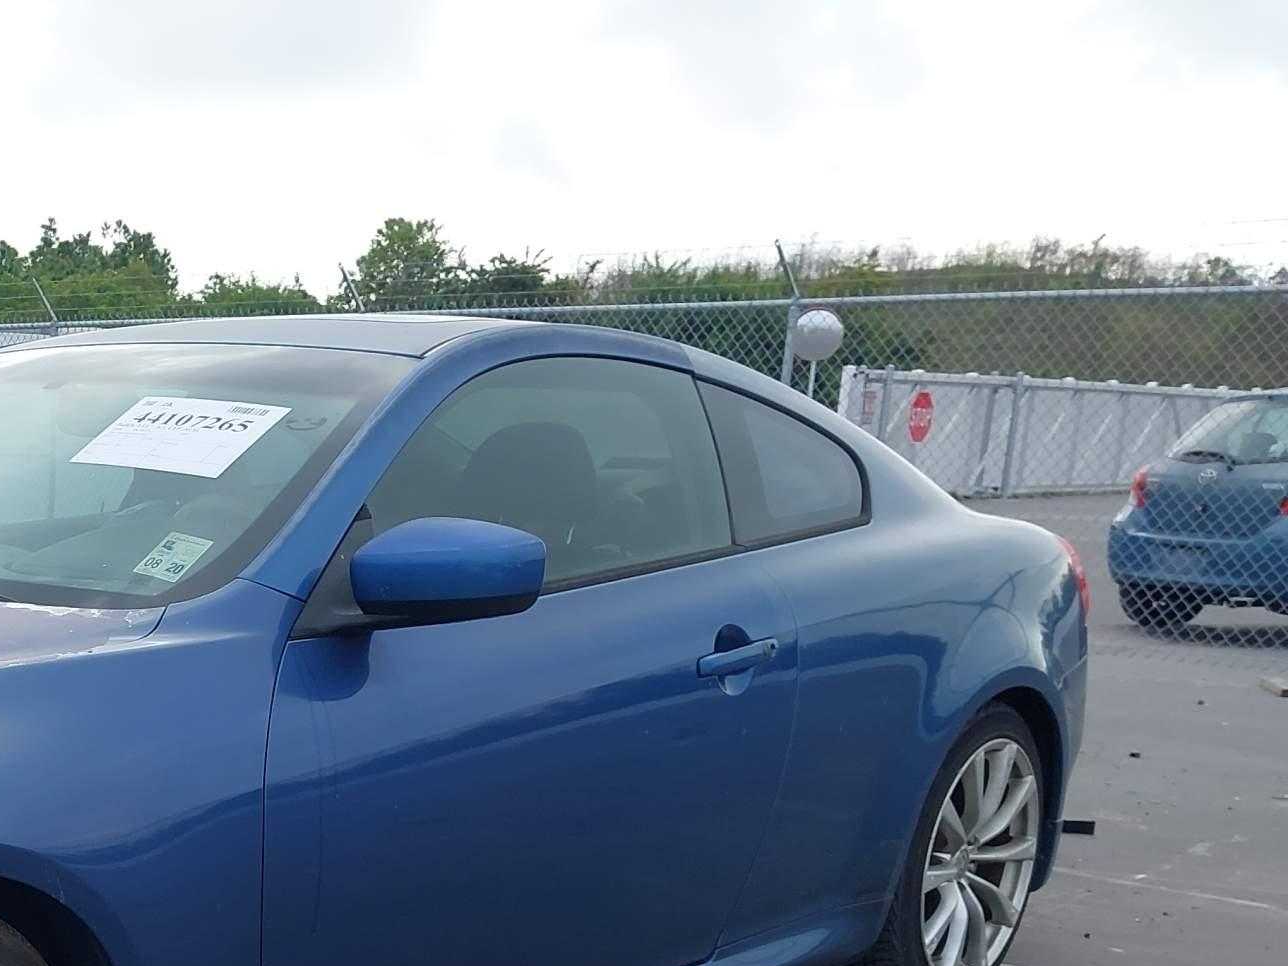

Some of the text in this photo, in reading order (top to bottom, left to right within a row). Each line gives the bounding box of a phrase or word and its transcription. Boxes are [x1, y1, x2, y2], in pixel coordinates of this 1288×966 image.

[133, 410, 255, 433] 44107265
[144, 557, 185, 575] 08 20
